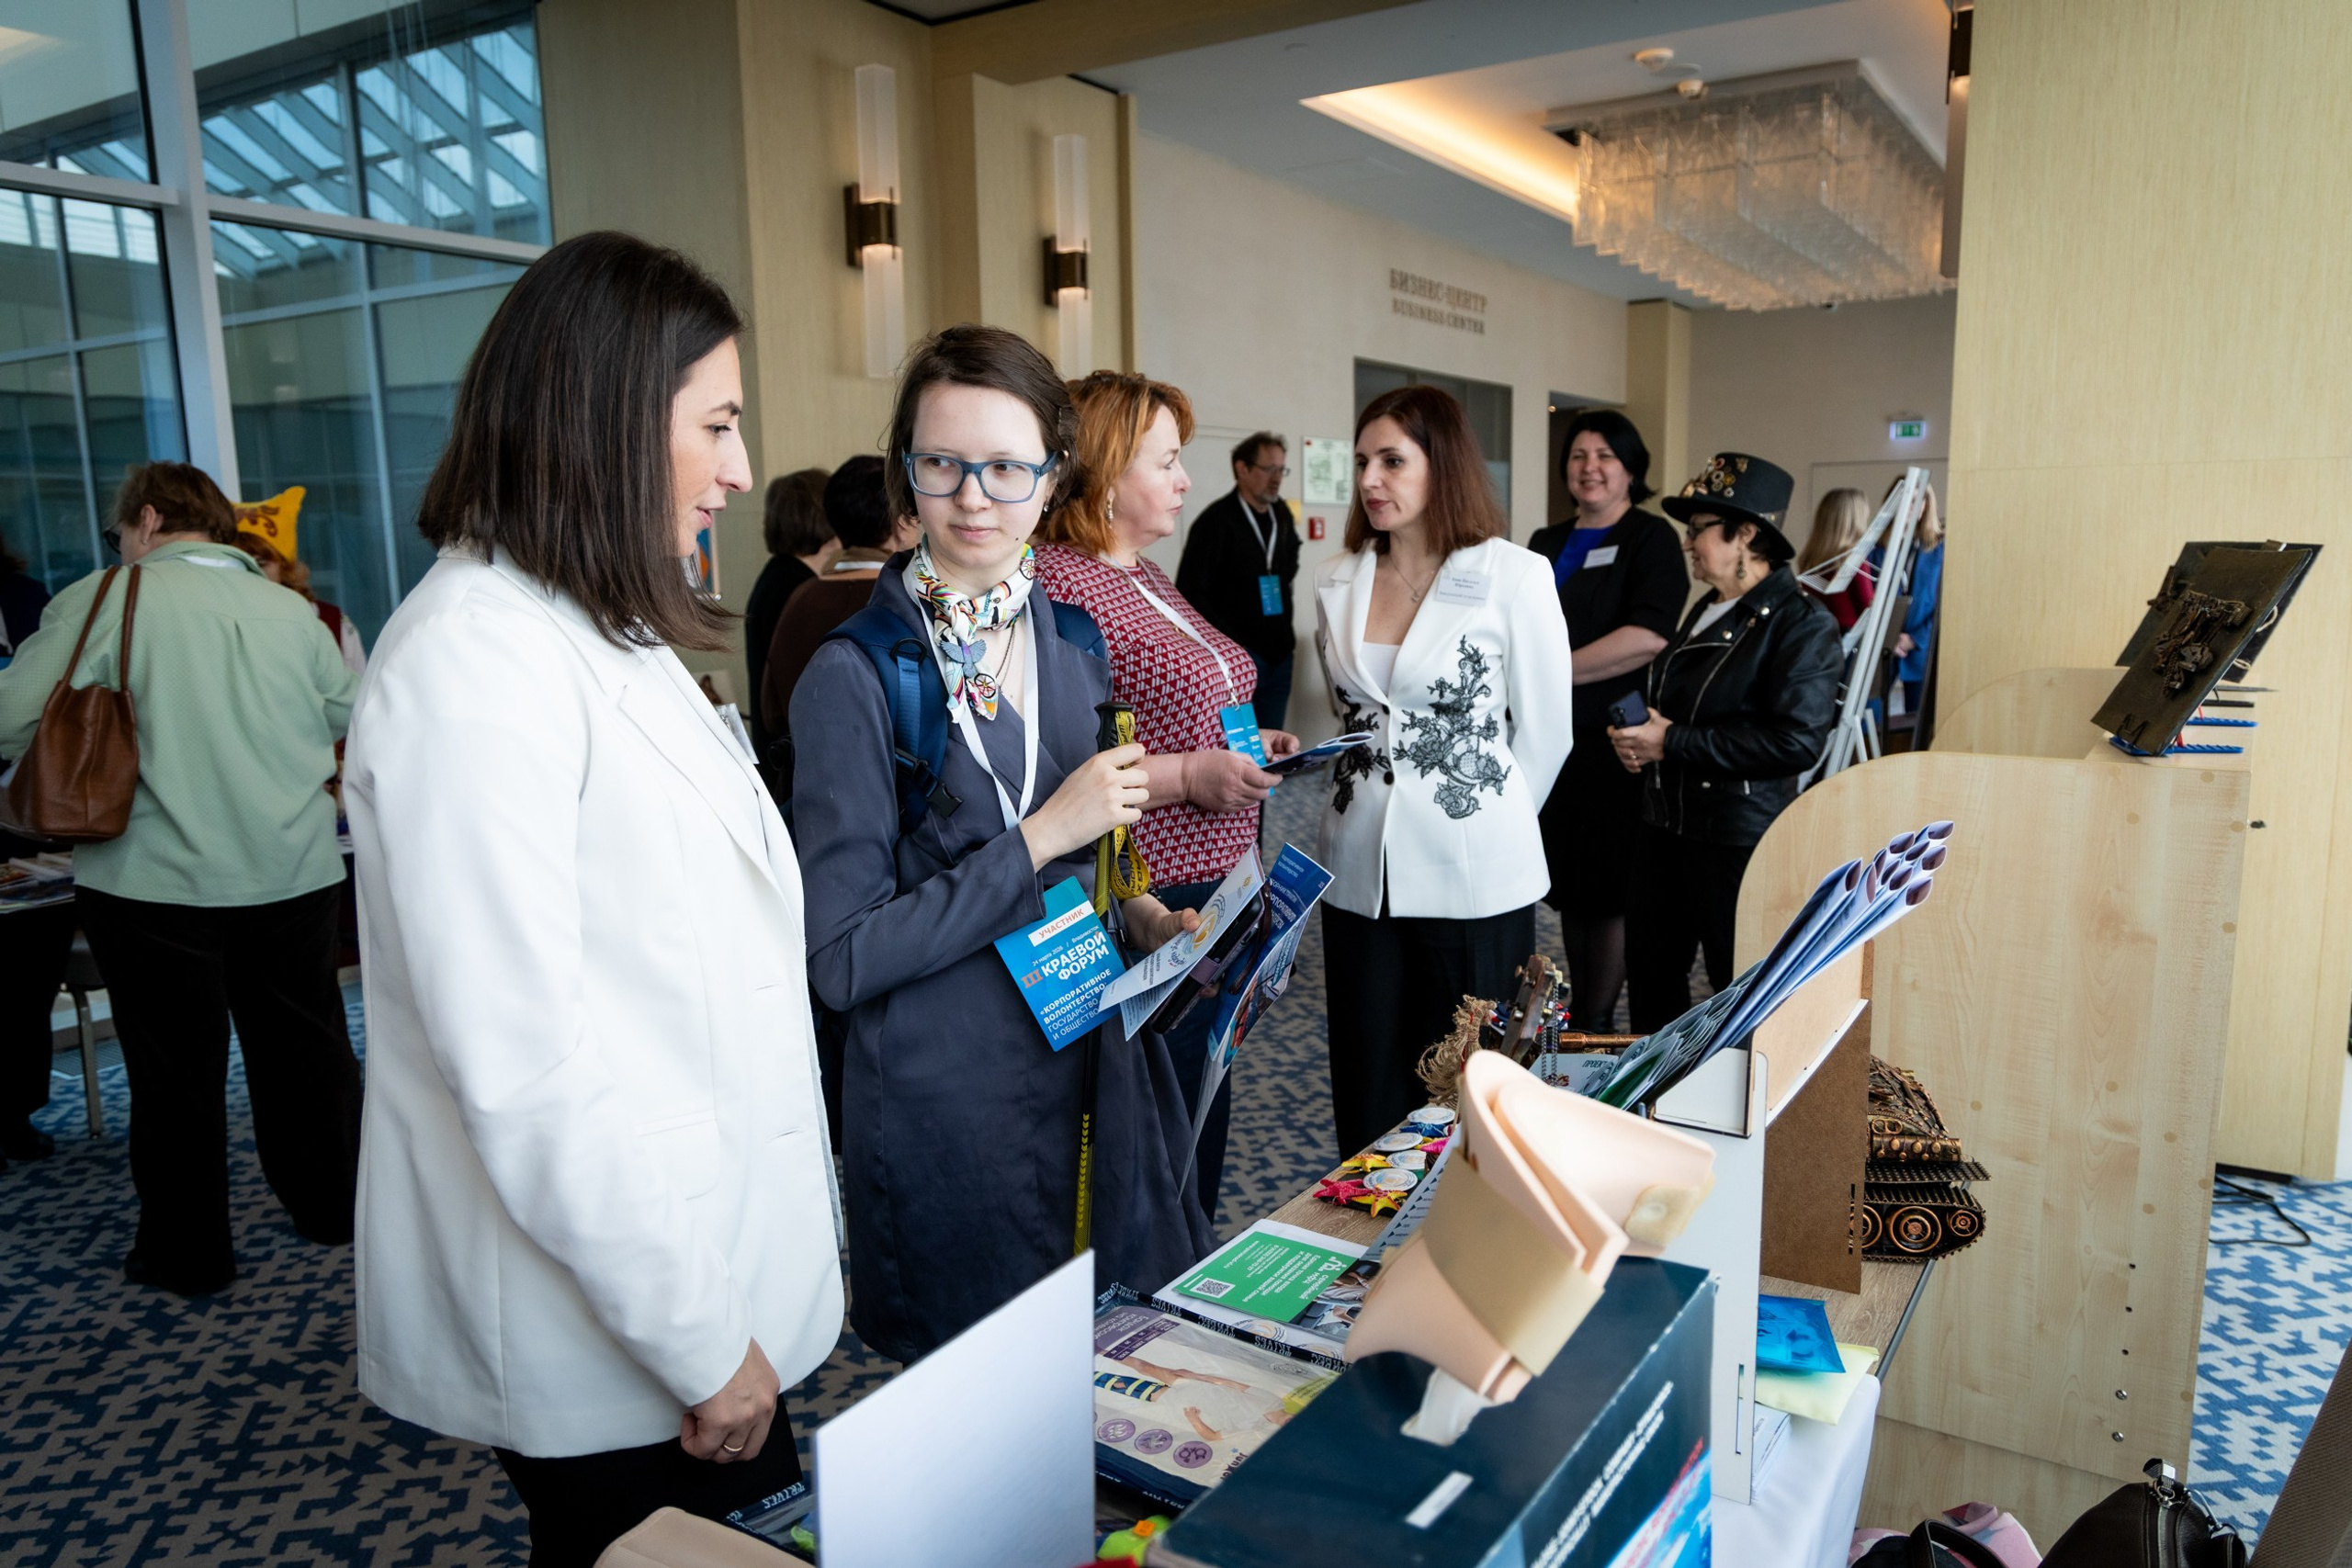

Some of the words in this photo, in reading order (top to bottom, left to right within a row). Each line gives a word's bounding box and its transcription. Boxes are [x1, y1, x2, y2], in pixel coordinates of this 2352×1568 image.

[1039, 908, 1084, 939] УЧАСТНИК
[1041, 931, 1106, 977] КРАЕВОЙ
[1058, 942, 1109, 980] ФОРУМ
[1040, 969, 1112, 1015] «КОРПОРАТИВНОЕ
[1048, 998, 1099, 1032] ГОСУДАРСТВО
[1052, 1032, 1060, 1041] И
[1289, 1269, 1304, 1281] точка
[1298, 1274, 1329, 1300] семейный
[1150, 1297, 1182, 1317] TRIVES
[1254, 1336, 1292, 1358] TRIVES
[1310, 1353, 1348, 1372] РИВЕС
[763, 1482, 806, 1509] TRIVES
